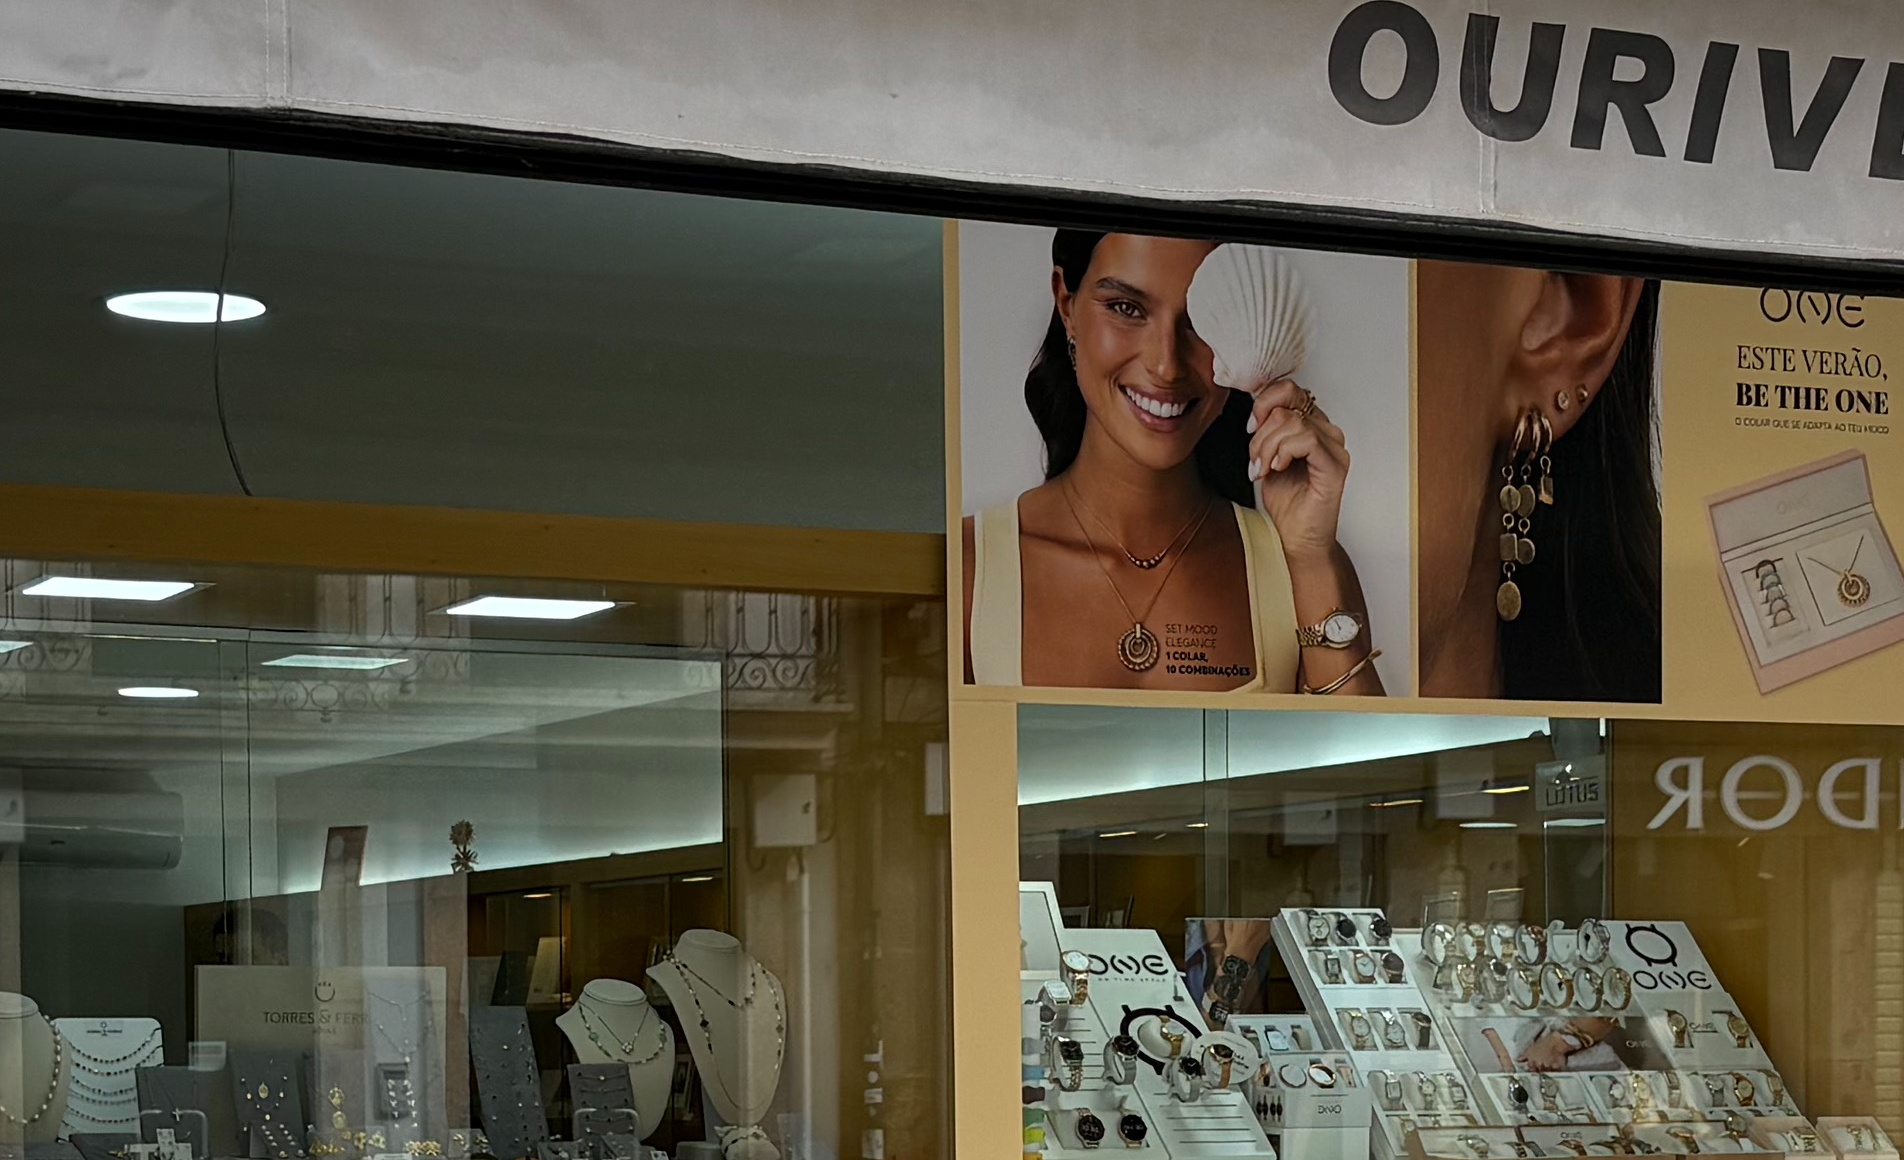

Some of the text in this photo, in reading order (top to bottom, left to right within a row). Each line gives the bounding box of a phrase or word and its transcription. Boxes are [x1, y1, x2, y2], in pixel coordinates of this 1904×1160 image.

[1760, 287, 1864, 328] ONE
[1737, 345, 1888, 381] ESTE VERÃO,
[1736, 382, 1889, 415] BE THE ONE
[1165, 652, 1170, 660] 1
[1166, 665, 1176, 674] 10
[263, 1010, 316, 1025] TORRES
